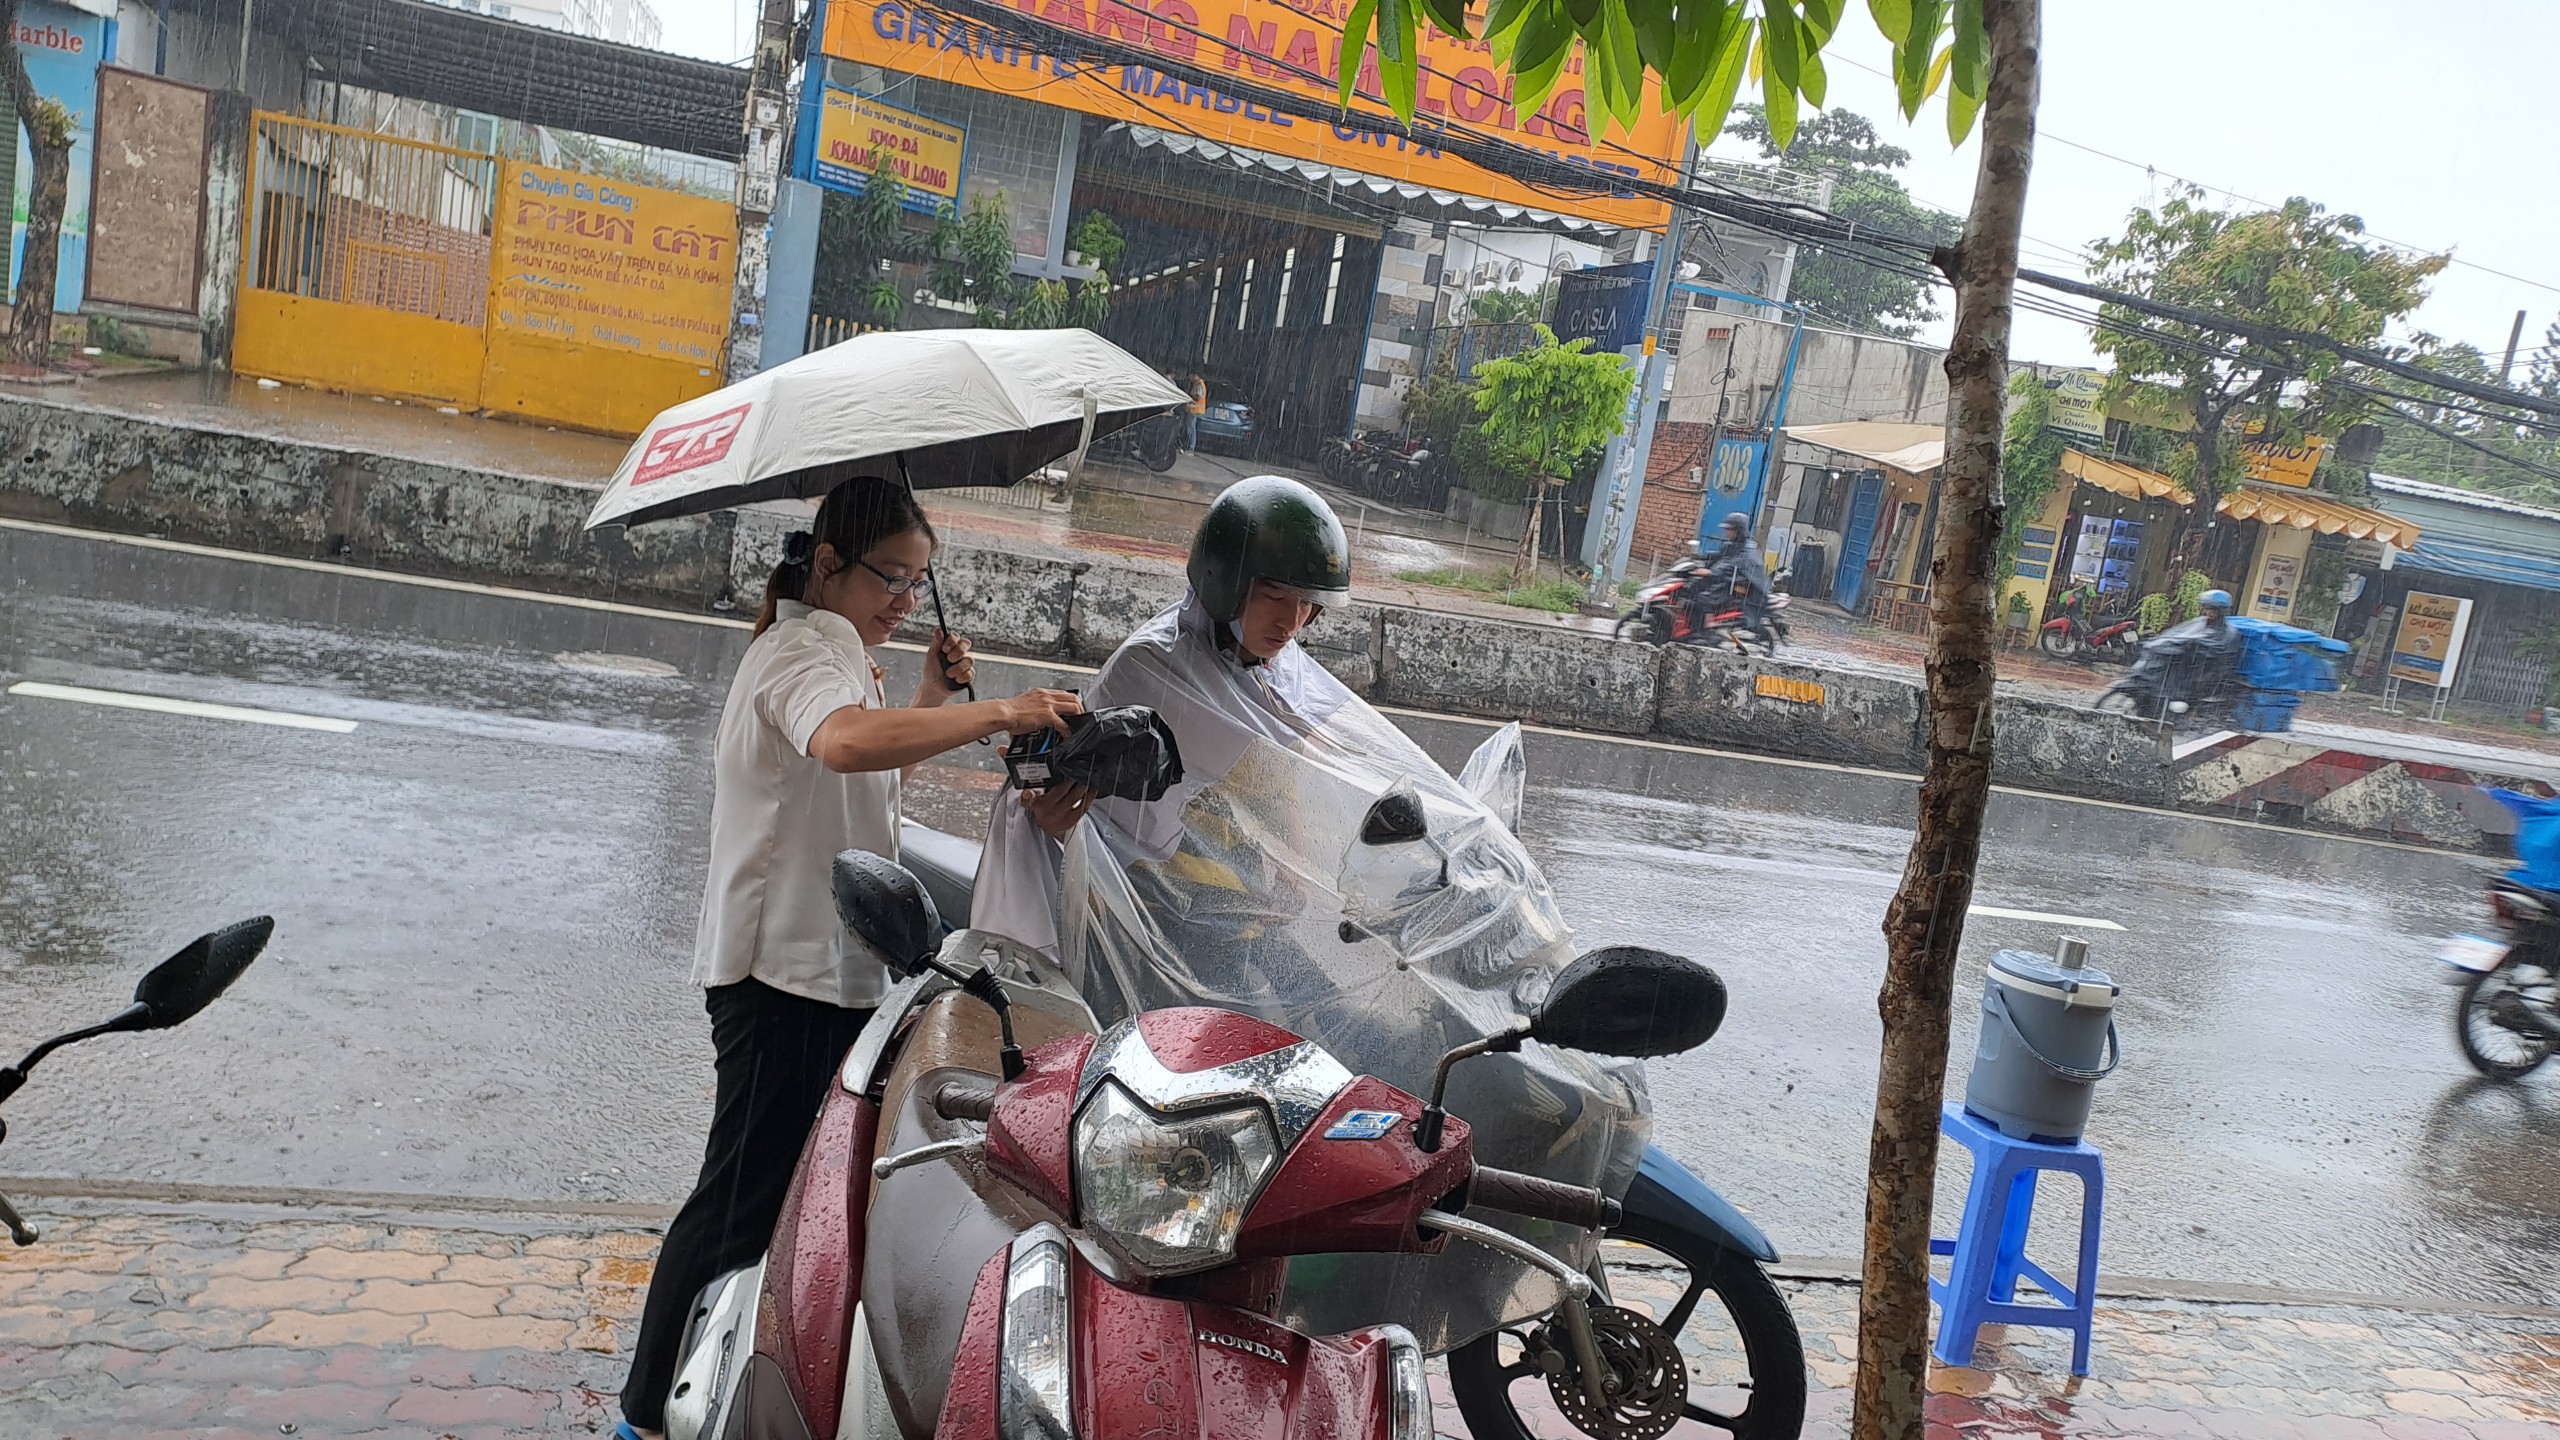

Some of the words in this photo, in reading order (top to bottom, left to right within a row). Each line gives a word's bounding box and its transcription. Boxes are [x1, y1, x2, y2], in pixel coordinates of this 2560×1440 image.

[868, 127, 898, 149] KHO
[901, 136, 918, 155] ĐÁ
[521, 171, 569, 198] Chuyên
[573, 182, 594, 202] Gia
[912, 163, 948, 189] LONG
[517, 199, 635, 245] PHUN
[653, 224, 729, 261] CÁT
[1570, 305, 1617, 333] CASLA
[1713, 443, 1753, 492] 303
[1197, 1328, 1290, 1367] HONDA
